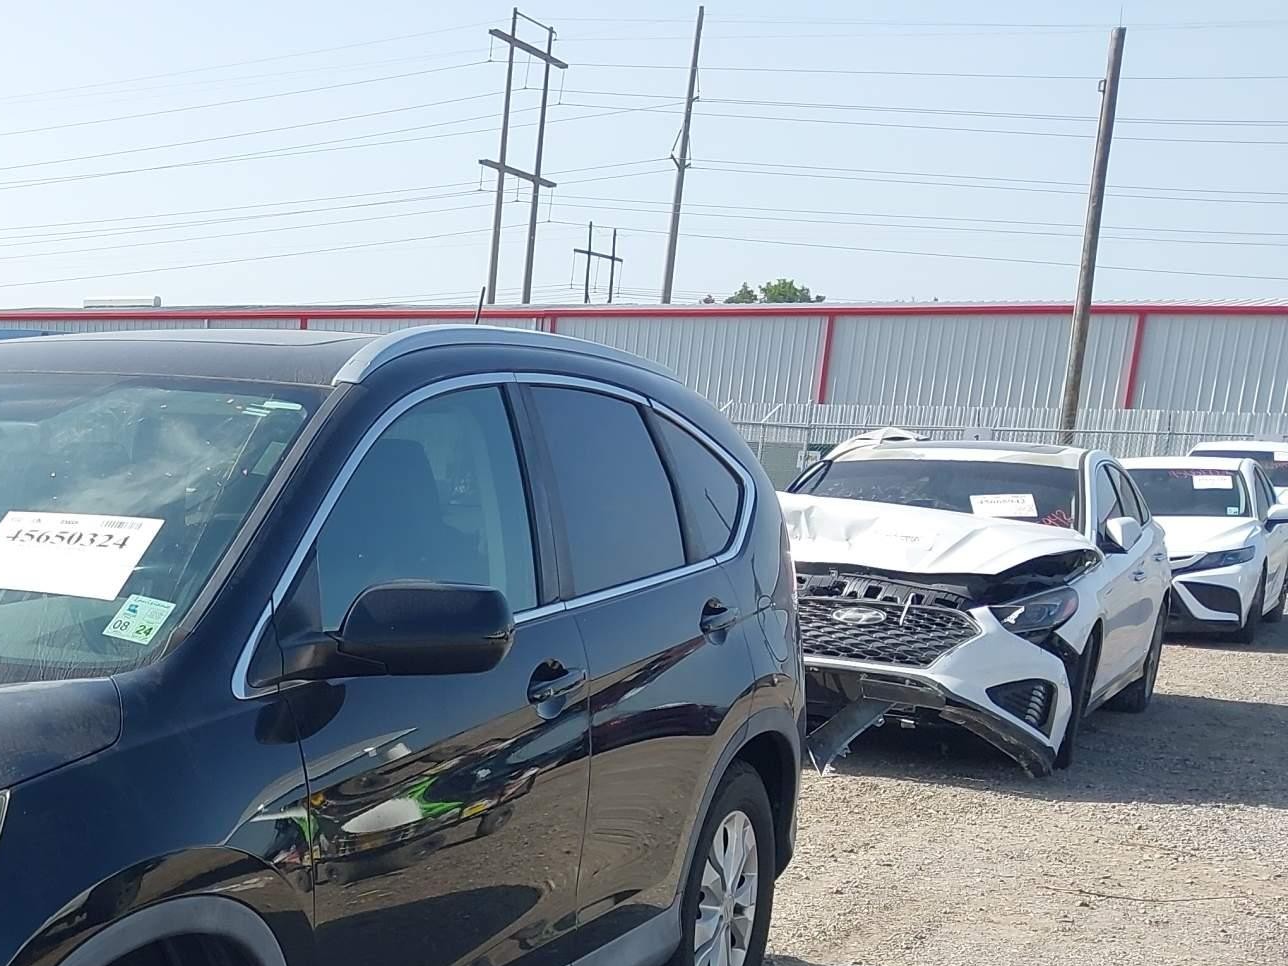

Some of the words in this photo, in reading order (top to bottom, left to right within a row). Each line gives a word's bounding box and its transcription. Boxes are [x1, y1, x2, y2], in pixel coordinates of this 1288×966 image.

[6, 529, 130, 549] 45650324
[112, 619, 130, 631] 08
[135, 624, 153, 637] 24
